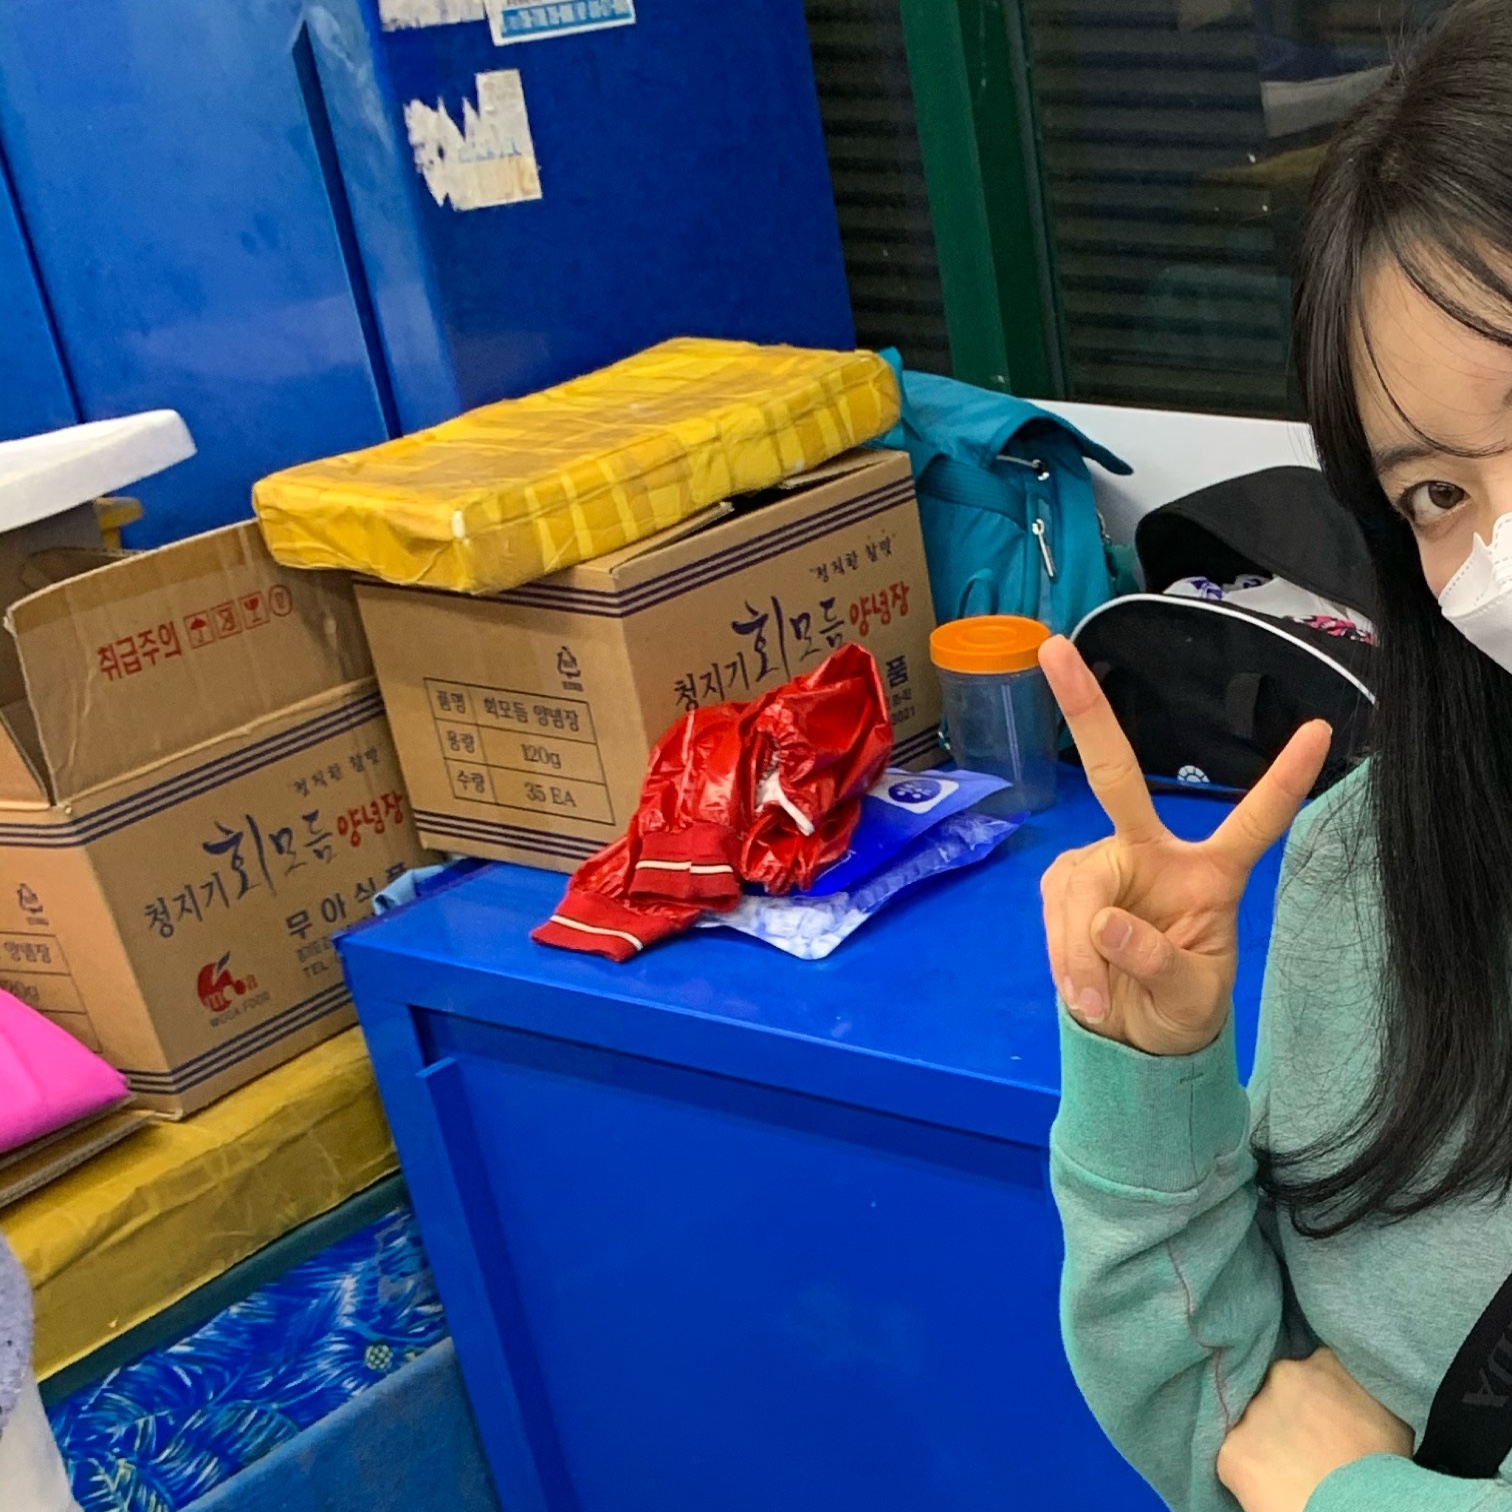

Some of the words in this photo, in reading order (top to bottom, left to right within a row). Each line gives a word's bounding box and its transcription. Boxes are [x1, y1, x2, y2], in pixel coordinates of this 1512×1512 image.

[850, 581, 909, 637] 양념장
[97, 620, 183, 682] 취급주의
[533, 704, 579, 732] 양념장
[447, 730, 475, 754] 용량
[457, 770, 485, 794] 수량
[524, 782, 547, 803] 35
[550, 786, 578, 808] EA
[144, 872, 230, 938] 청지기
[337, 789, 404, 847] 양념장
